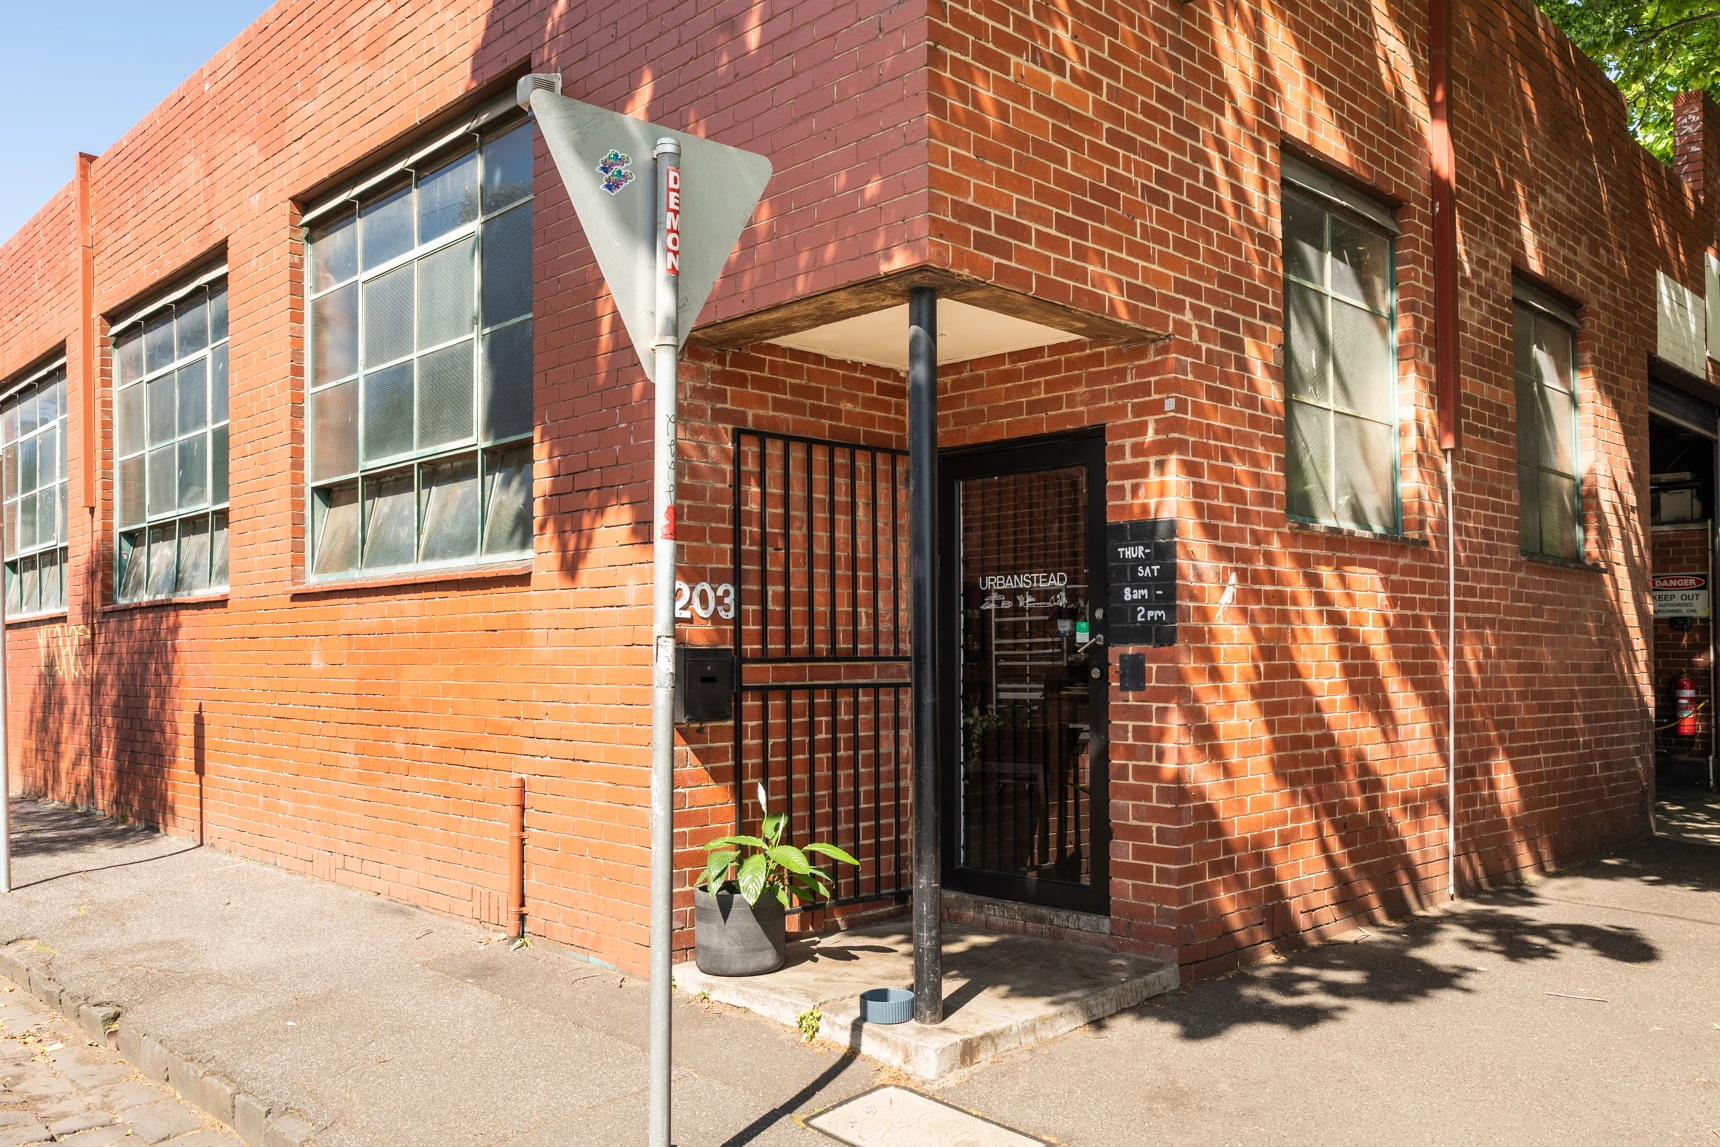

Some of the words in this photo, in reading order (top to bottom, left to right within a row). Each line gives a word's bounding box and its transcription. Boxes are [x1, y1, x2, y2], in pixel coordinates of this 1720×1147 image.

[666, 170, 680, 271] DEMON
[1118, 546, 1151, 559] THUR-
[1137, 565, 1160, 577] SAT
[980, 572, 1067, 590] URBANSTEAD
[1654, 579, 1696, 587] DANGER
[675, 581, 735, 619] 203
[1123, 587, 1149, 601] 8am
